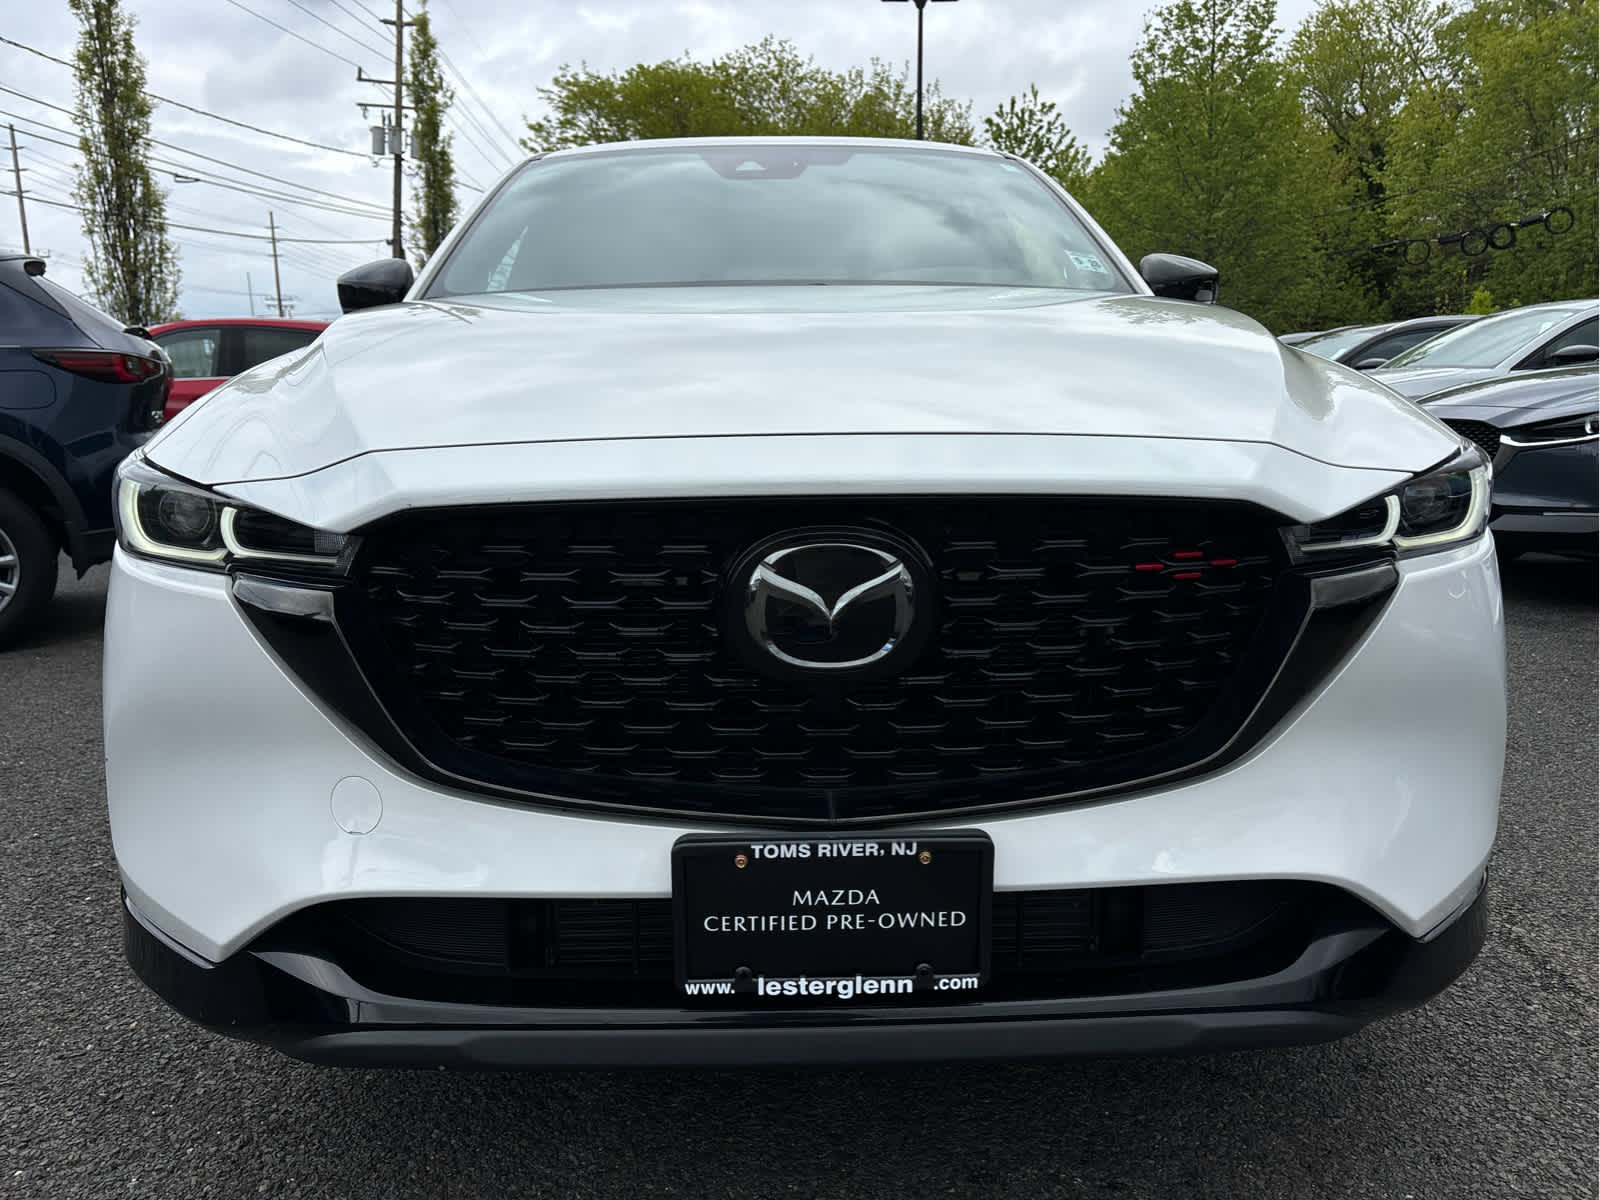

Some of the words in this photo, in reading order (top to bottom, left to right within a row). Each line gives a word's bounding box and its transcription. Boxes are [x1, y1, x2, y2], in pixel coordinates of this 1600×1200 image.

[751, 843, 811, 859] TOMS
[818, 842, 884, 857] RIVER,
[892, 842, 917, 856] NJ
[792, 889, 880, 906] MAZDA
[704, 915, 817, 932] CERTIFIED
[827, 912, 966, 930] PRE-OWNED
[685, 983, 735, 995] www.
[758, 977, 913, 999] lesterglenn
[934, 976, 979, 990] .com
